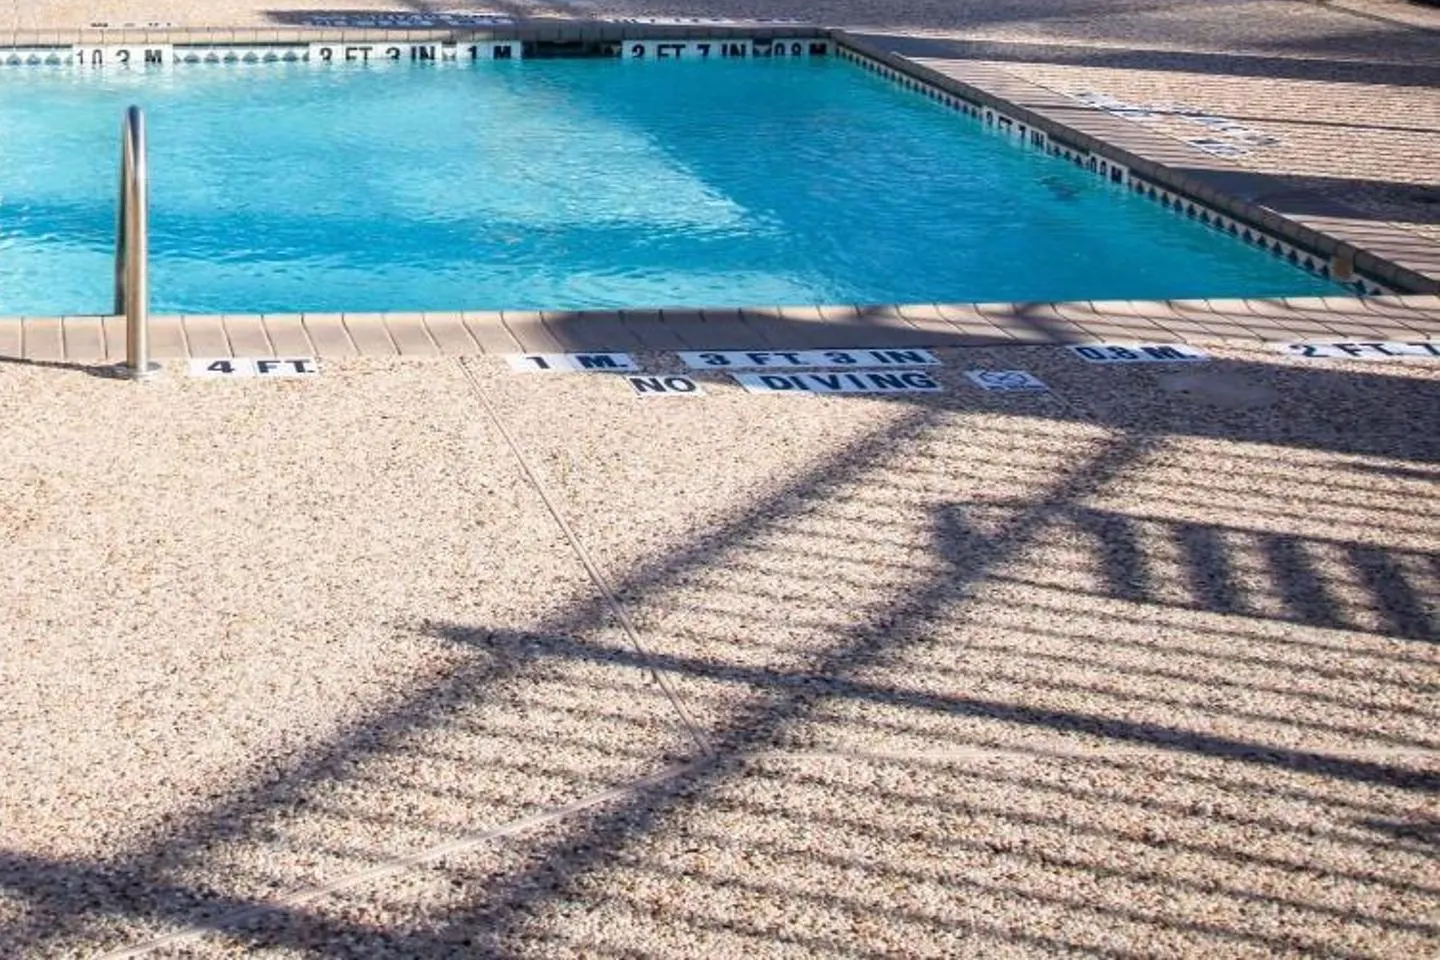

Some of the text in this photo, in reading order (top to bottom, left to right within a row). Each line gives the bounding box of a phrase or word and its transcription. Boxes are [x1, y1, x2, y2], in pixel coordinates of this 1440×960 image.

[1289, 343, 1328, 358] 2
[526, 356, 551, 370] 1
[698, 352, 731, 366] 3
[207, 360, 235, 373] 4
[630, 374, 937, 393] NO DIVING
